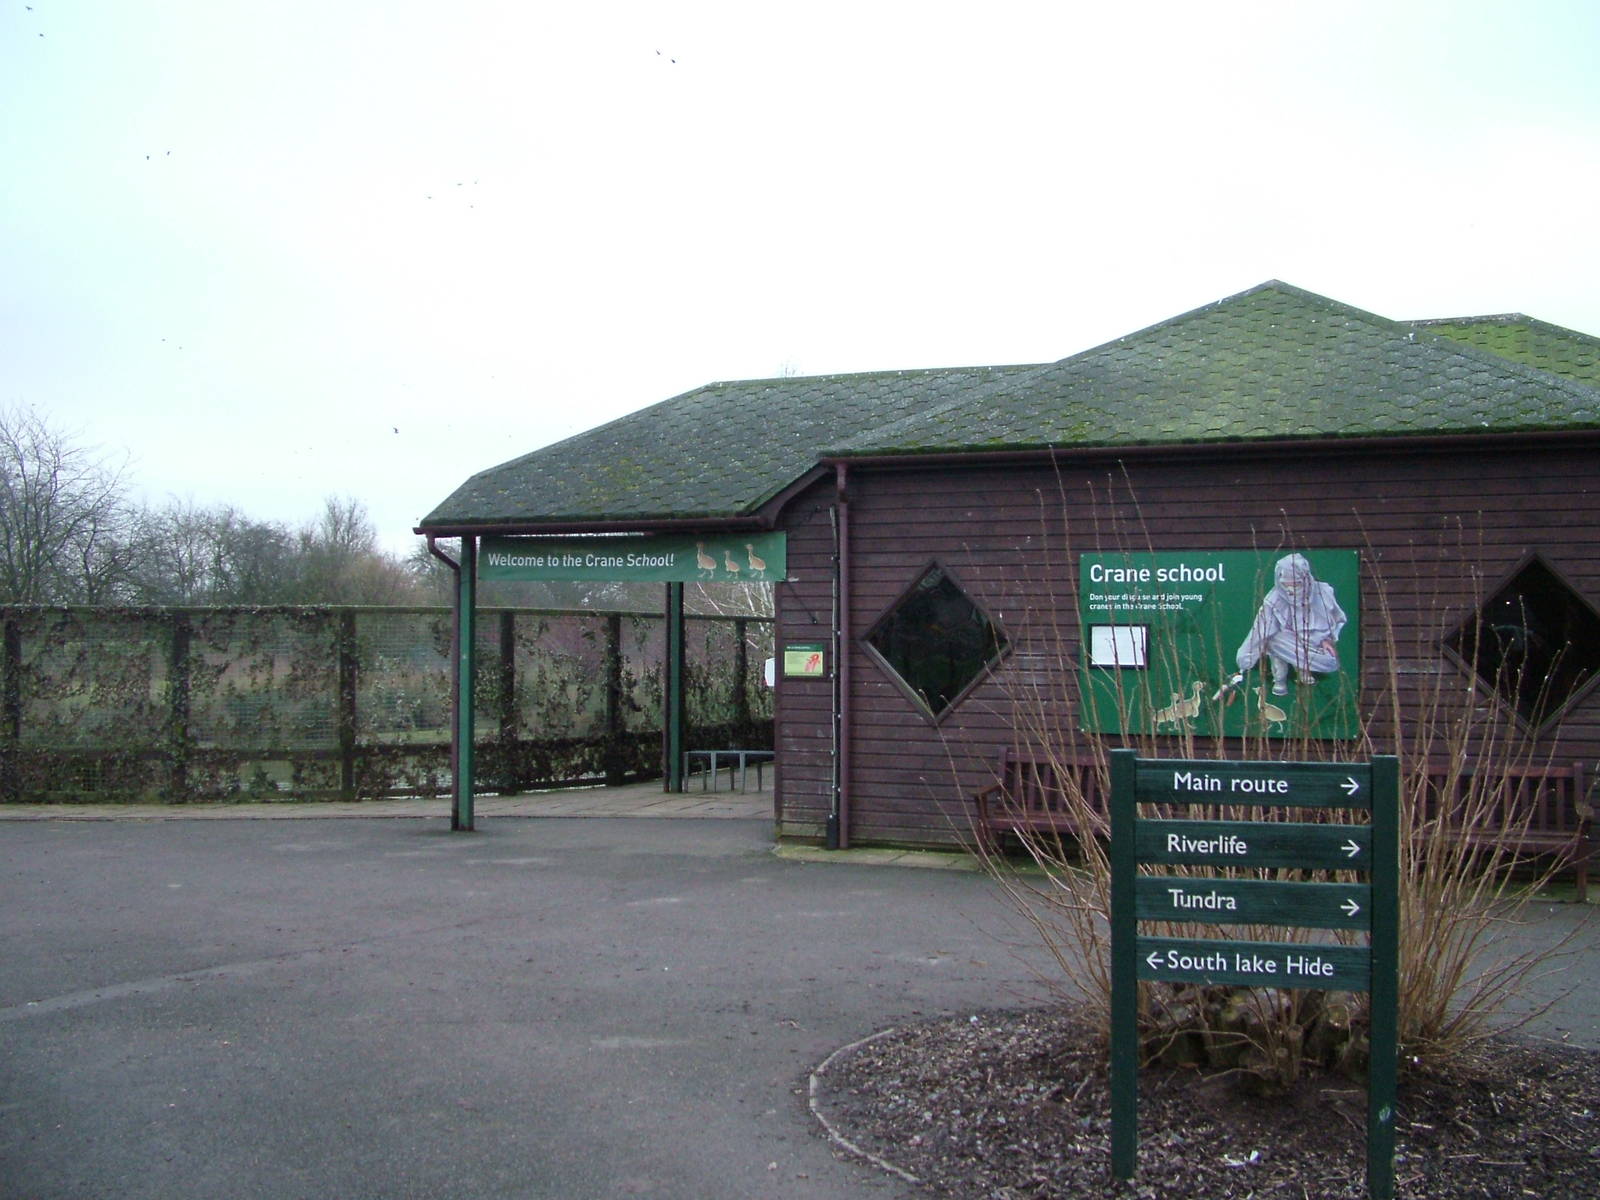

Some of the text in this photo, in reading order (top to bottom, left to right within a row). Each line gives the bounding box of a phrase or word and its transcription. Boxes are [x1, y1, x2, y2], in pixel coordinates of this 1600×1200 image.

[488, 553, 675, 567] Welcome to the Crane School!
[1090, 563, 1225, 583] Crane school
[1089, 593, 1104, 601] Don
[1104, 594, 1120, 602] your
[1151, 593, 1165, 601] and
[1165, 593, 1180, 602] join
[1180, 594, 1203, 602] young
[1114, 602, 1121, 610] in
[1173, 771, 1289, 794] Main route
[1167, 833, 1248, 855] Riverlife
[1168, 888, 1237, 910] Tundra
[1167, 950, 1334, 976] South lake Hide
